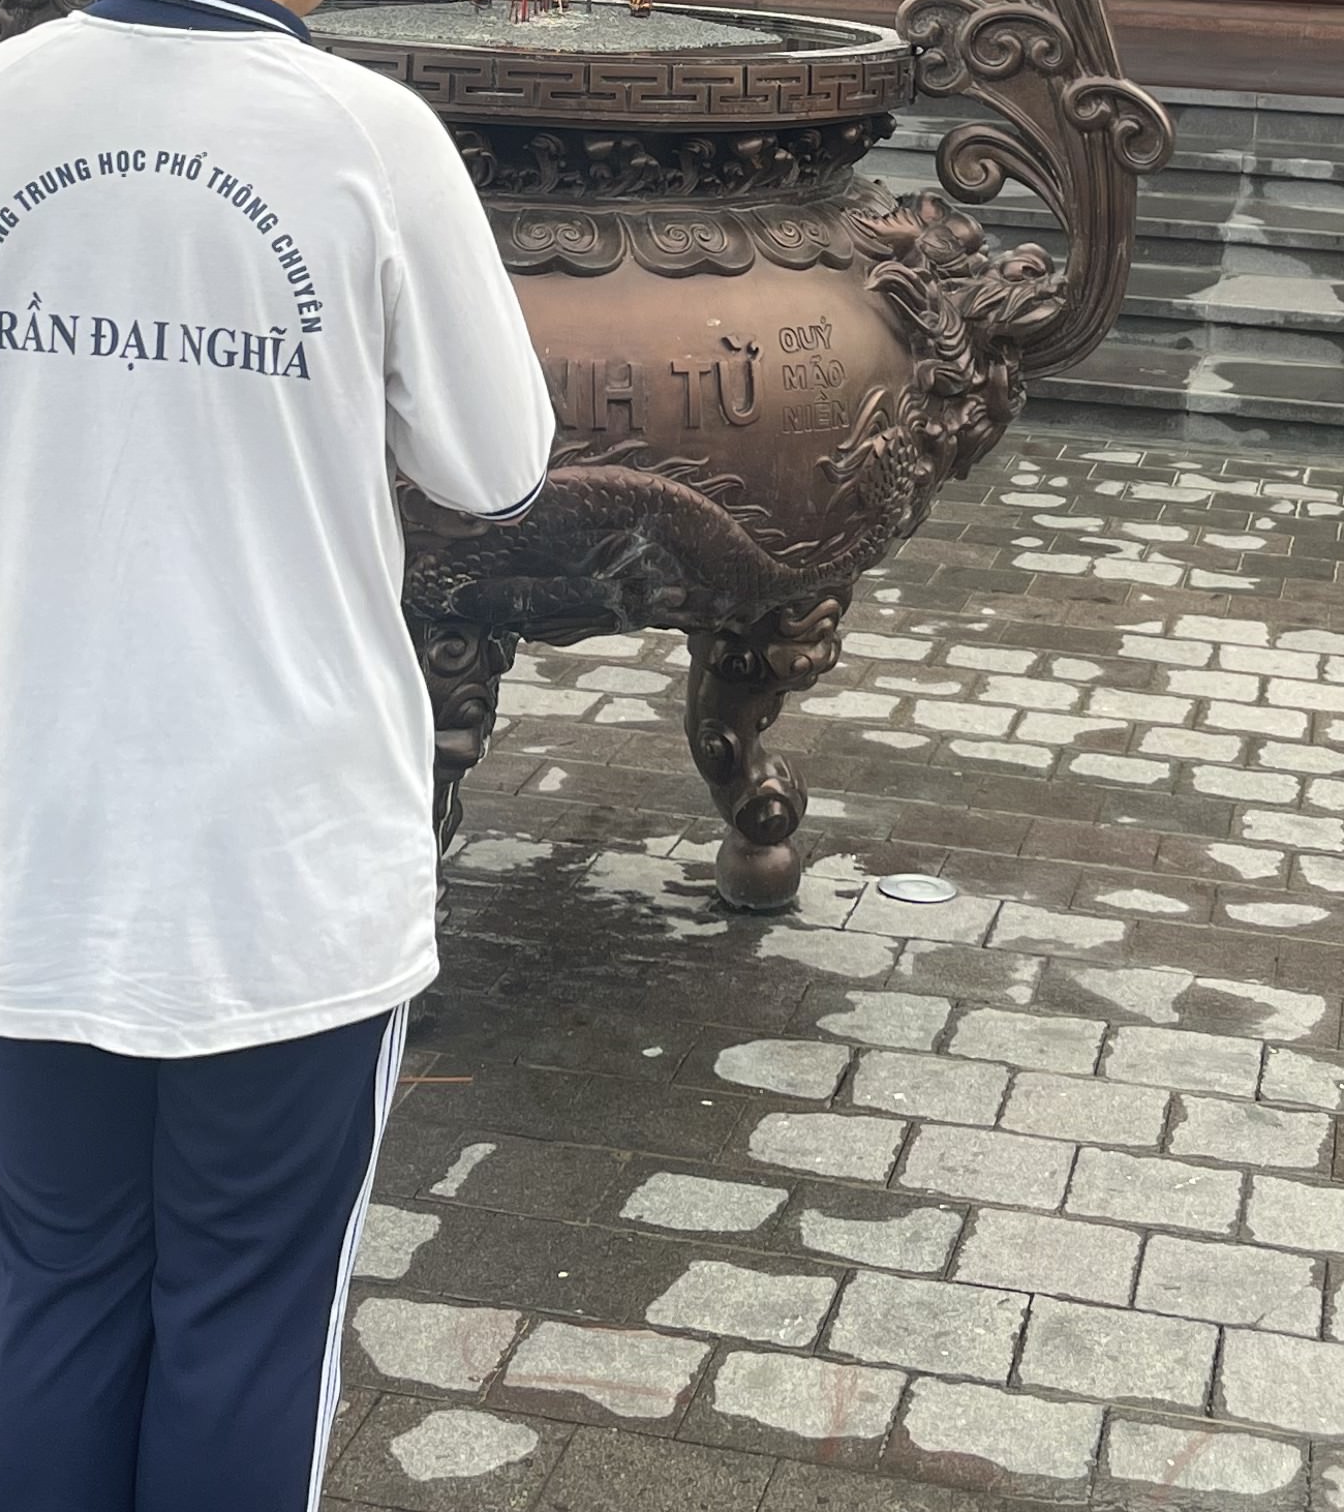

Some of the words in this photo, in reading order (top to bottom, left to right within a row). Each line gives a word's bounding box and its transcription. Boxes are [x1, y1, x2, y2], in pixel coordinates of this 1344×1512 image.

[13, 158, 92, 213] TRUNG
[98, 149, 147, 178] HỌC
[155, 150, 208, 181] PHỔ
[207, 167, 280, 235] THÔNG
[270, 233, 325, 335] CHUYÊN
[90, 316, 170, 372] ĐẠI
[179, 323, 311, 380] NGHĨA
[668, 334, 765, 430] TỪ
[781, 354, 848, 392] MÃO
